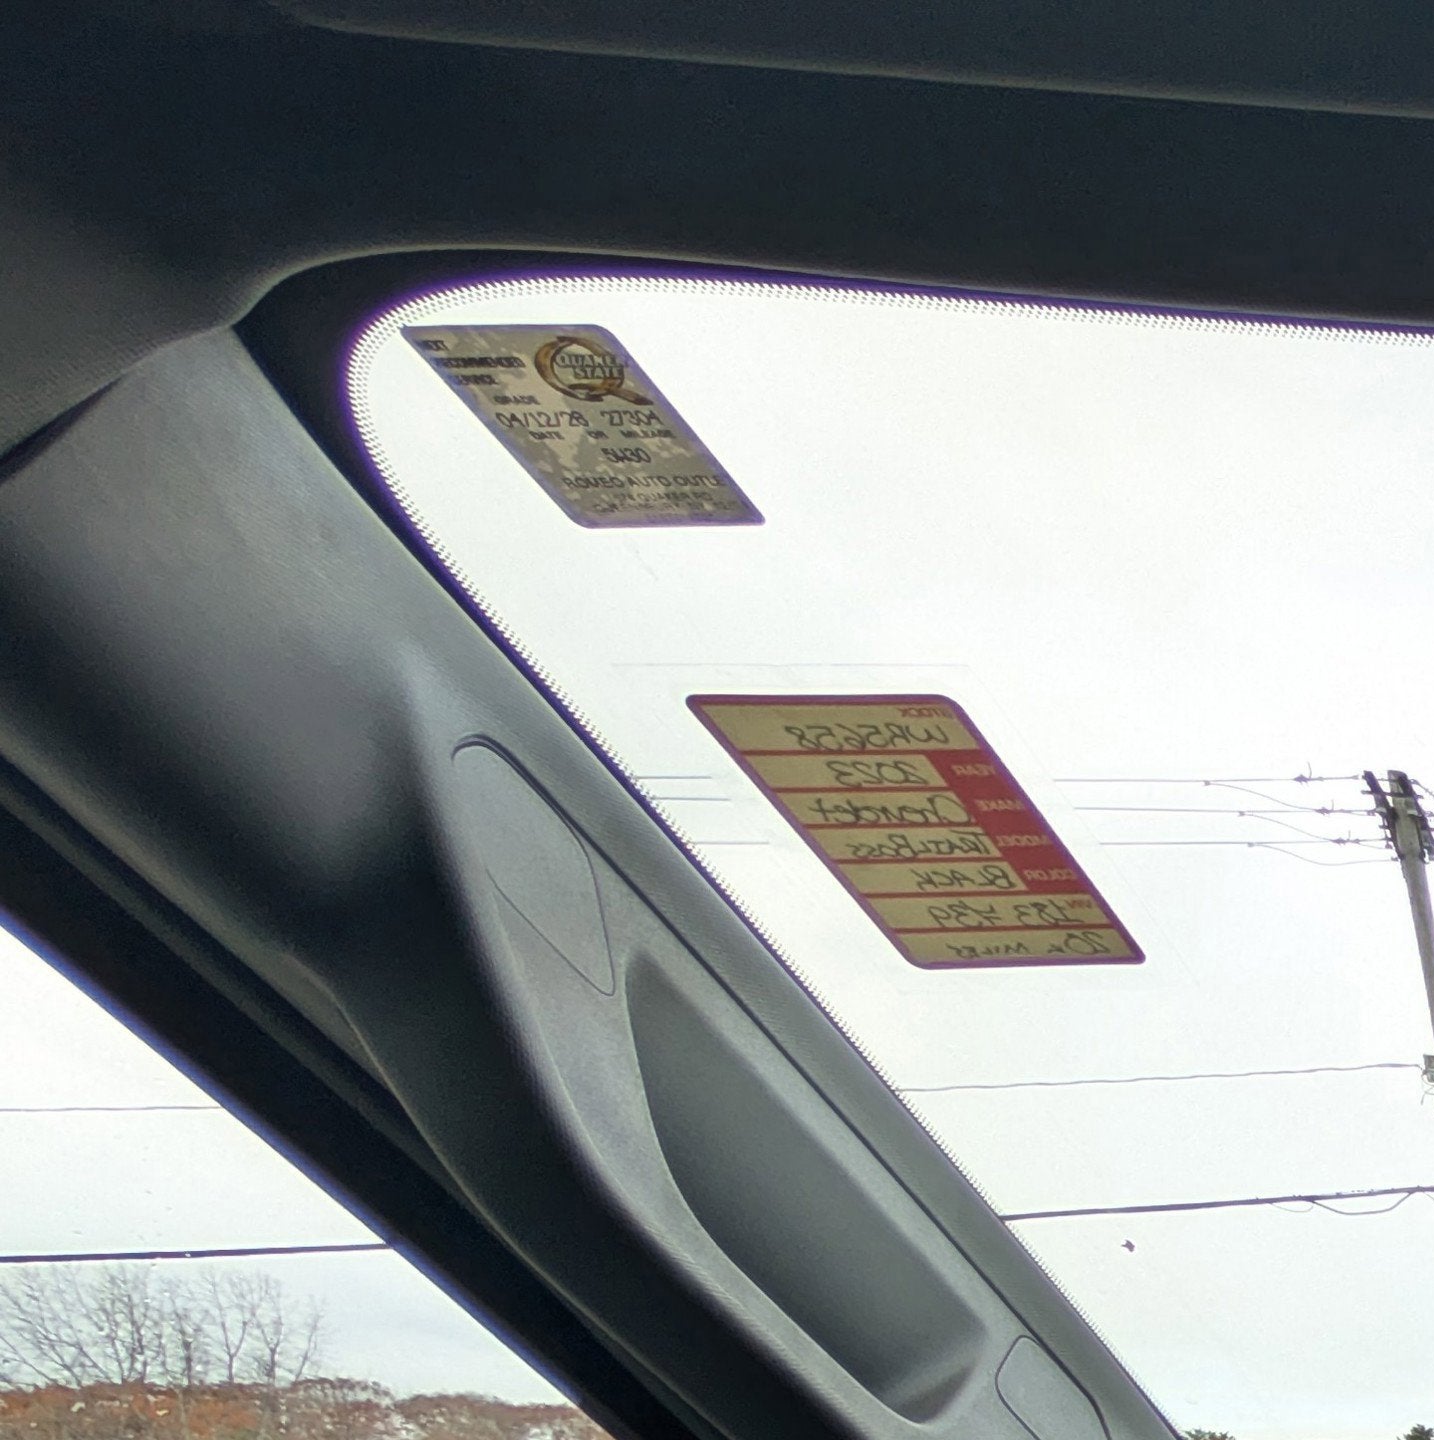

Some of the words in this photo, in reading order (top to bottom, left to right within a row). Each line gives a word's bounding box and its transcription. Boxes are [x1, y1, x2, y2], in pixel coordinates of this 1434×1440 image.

[531, 431, 564, 440] DATE
[564, 477, 623, 489] ROMEO
[627, 476, 671, 487] AUTO
